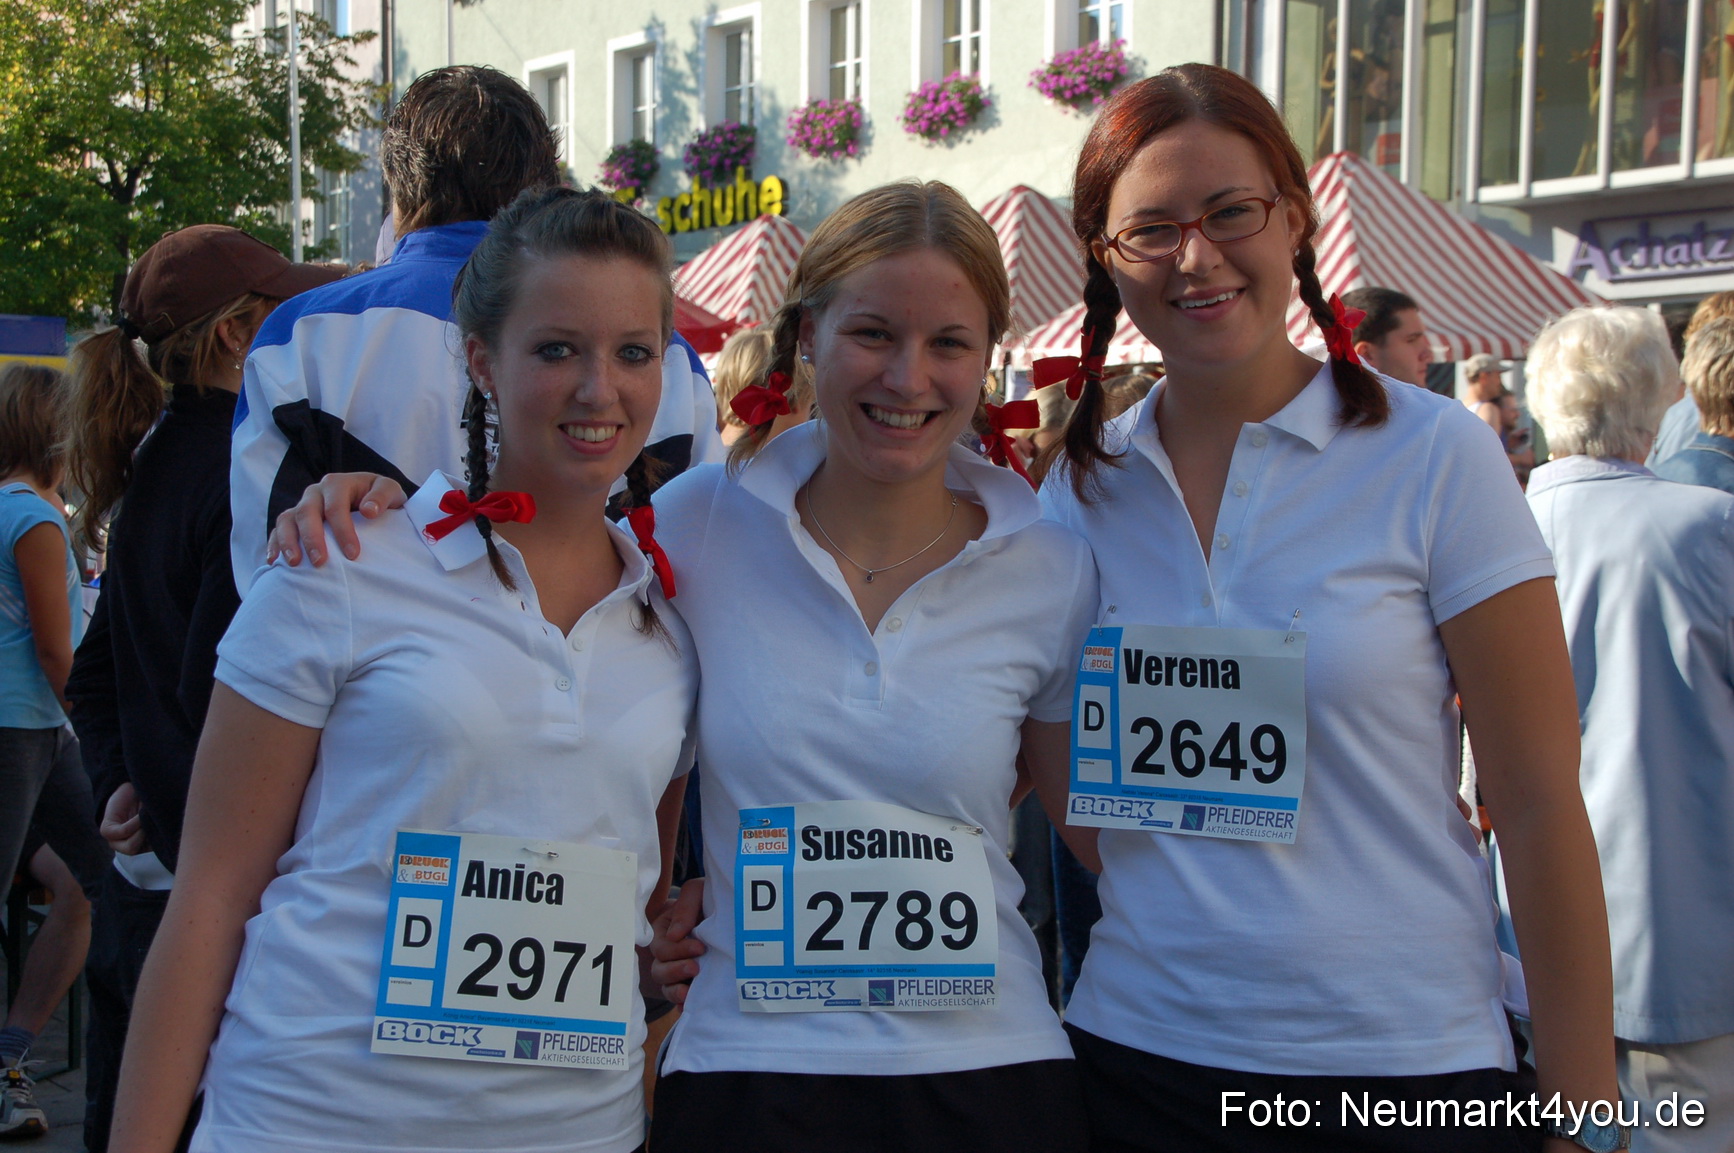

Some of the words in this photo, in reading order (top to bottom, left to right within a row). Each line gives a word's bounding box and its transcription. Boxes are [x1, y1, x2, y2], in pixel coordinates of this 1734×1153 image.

[657, 165, 783, 234] schuhe
[1566, 219, 1734, 282] Achatz
[1123, 648, 1241, 690] Verena
[1083, 700, 1105, 732] D
[1130, 716, 1288, 785] 2649
[1070, 796, 1156, 820] BOCK
[1207, 805, 1295, 830] PFLEIDERER
[801, 824, 955, 863] Susanne
[1205, 824, 1294, 840] AKTIENGESELLSCHAFT
[461, 859, 565, 906] Anica
[751, 880, 777, 912] D
[402, 914, 432, 948] D
[805, 889, 979, 952] 2789
[456, 932, 614, 1007] 2971
[740, 979, 836, 1000] BOCK
[898, 979, 995, 997] PFLEIDERER
[898, 997, 996, 1007] AKTIENGESELLSCHAFT
[377, 1019, 484, 1047] BOCK
[542, 1032, 625, 1055] PFLEIDERER
[541, 1053, 626, 1066] AKTIENGESELLSCHAFT
